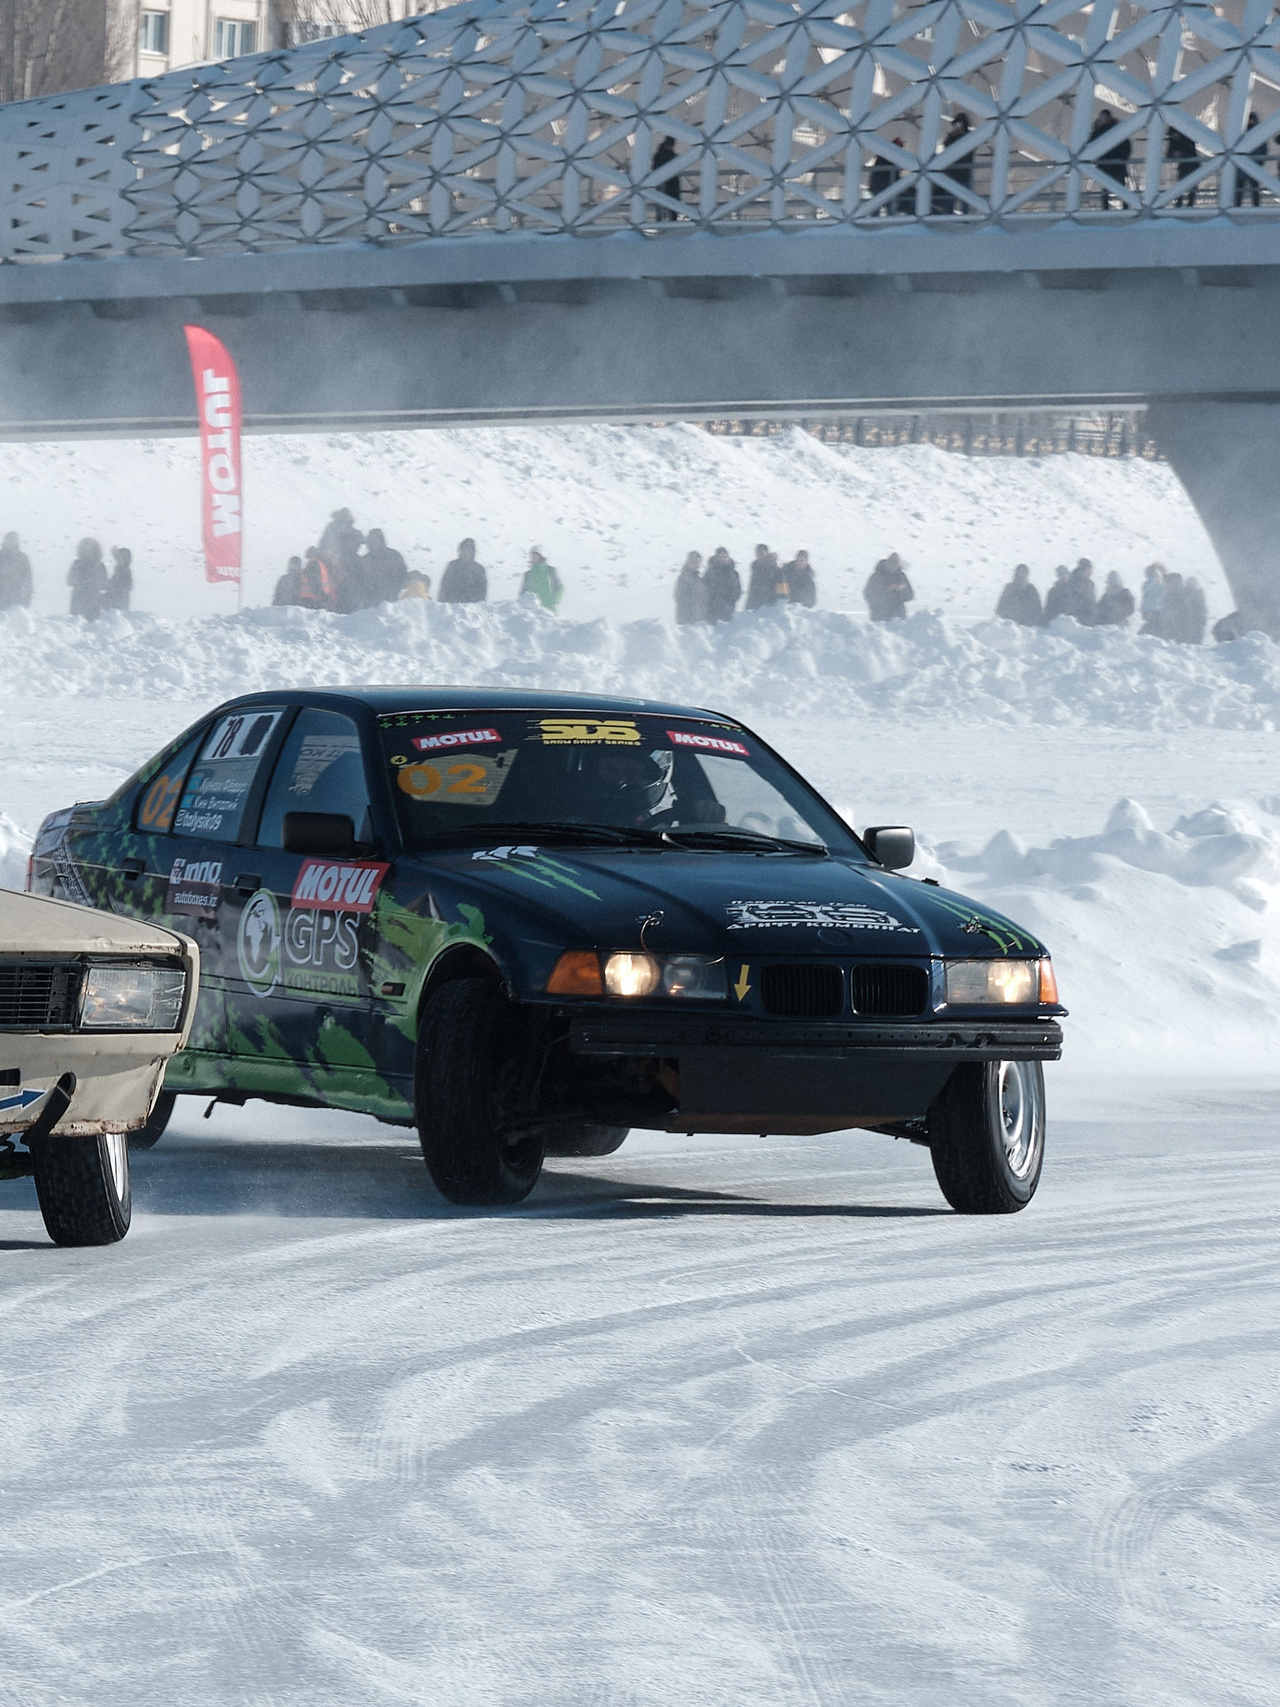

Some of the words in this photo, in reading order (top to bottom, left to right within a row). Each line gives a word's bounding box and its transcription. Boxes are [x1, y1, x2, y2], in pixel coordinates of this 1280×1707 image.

[420, 730, 497, 749] MOTUL
[674, 732, 746, 754] MOTUL
[397, 763, 488, 796] 02
[141, 774, 183, 828] 02
[295, 864, 380, 905] MOTUL
[285, 907, 361, 969] GPS
